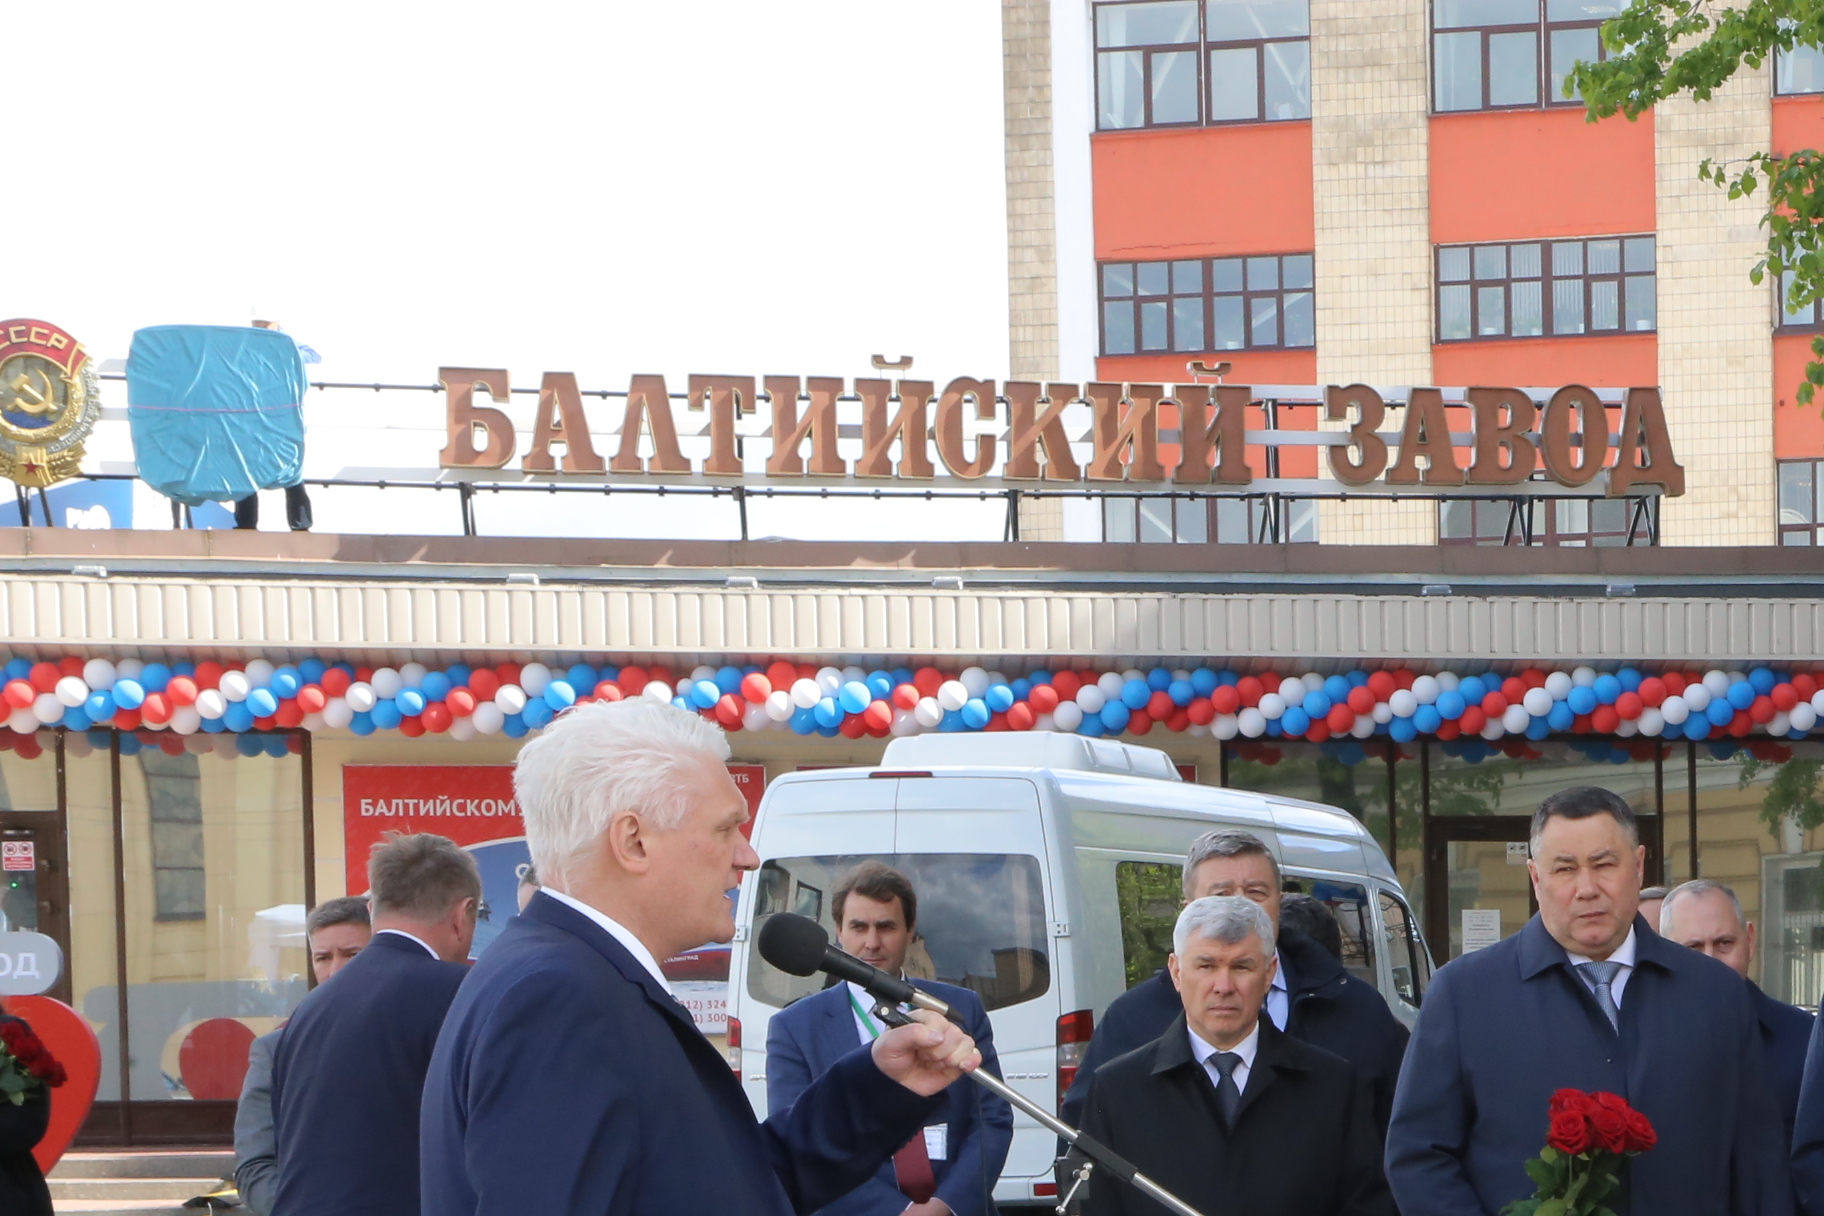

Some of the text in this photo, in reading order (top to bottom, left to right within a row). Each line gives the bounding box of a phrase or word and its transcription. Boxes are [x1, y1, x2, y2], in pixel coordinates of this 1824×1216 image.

[438, 354, 1686, 498] БАЛТИЙСКИЙ ЗАВОД
[360, 795, 523, 817] БАЛТИЙСКОМ
[707, 1000, 727, 1009] 324
[707, 1013, 727, 1022] 300
